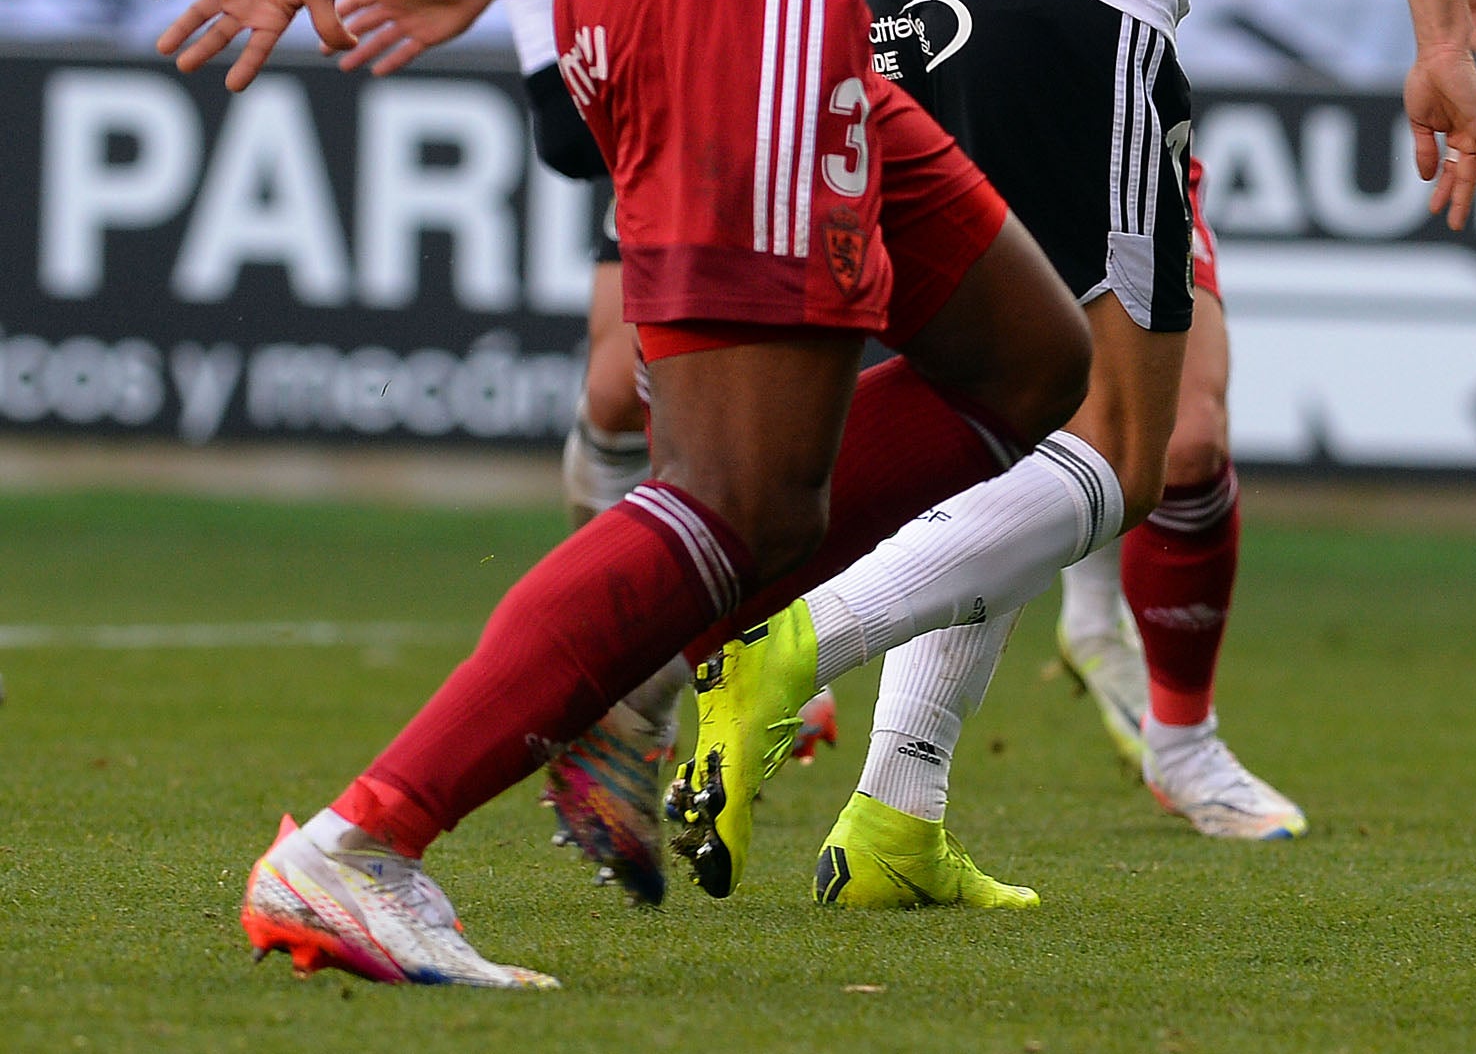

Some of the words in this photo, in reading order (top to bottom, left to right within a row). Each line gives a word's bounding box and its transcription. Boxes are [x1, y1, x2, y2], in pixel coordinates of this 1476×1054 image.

[821, 77, 870, 197] 3
[0, 332, 165, 423] cos
[897, 746, 942, 766] adidas
